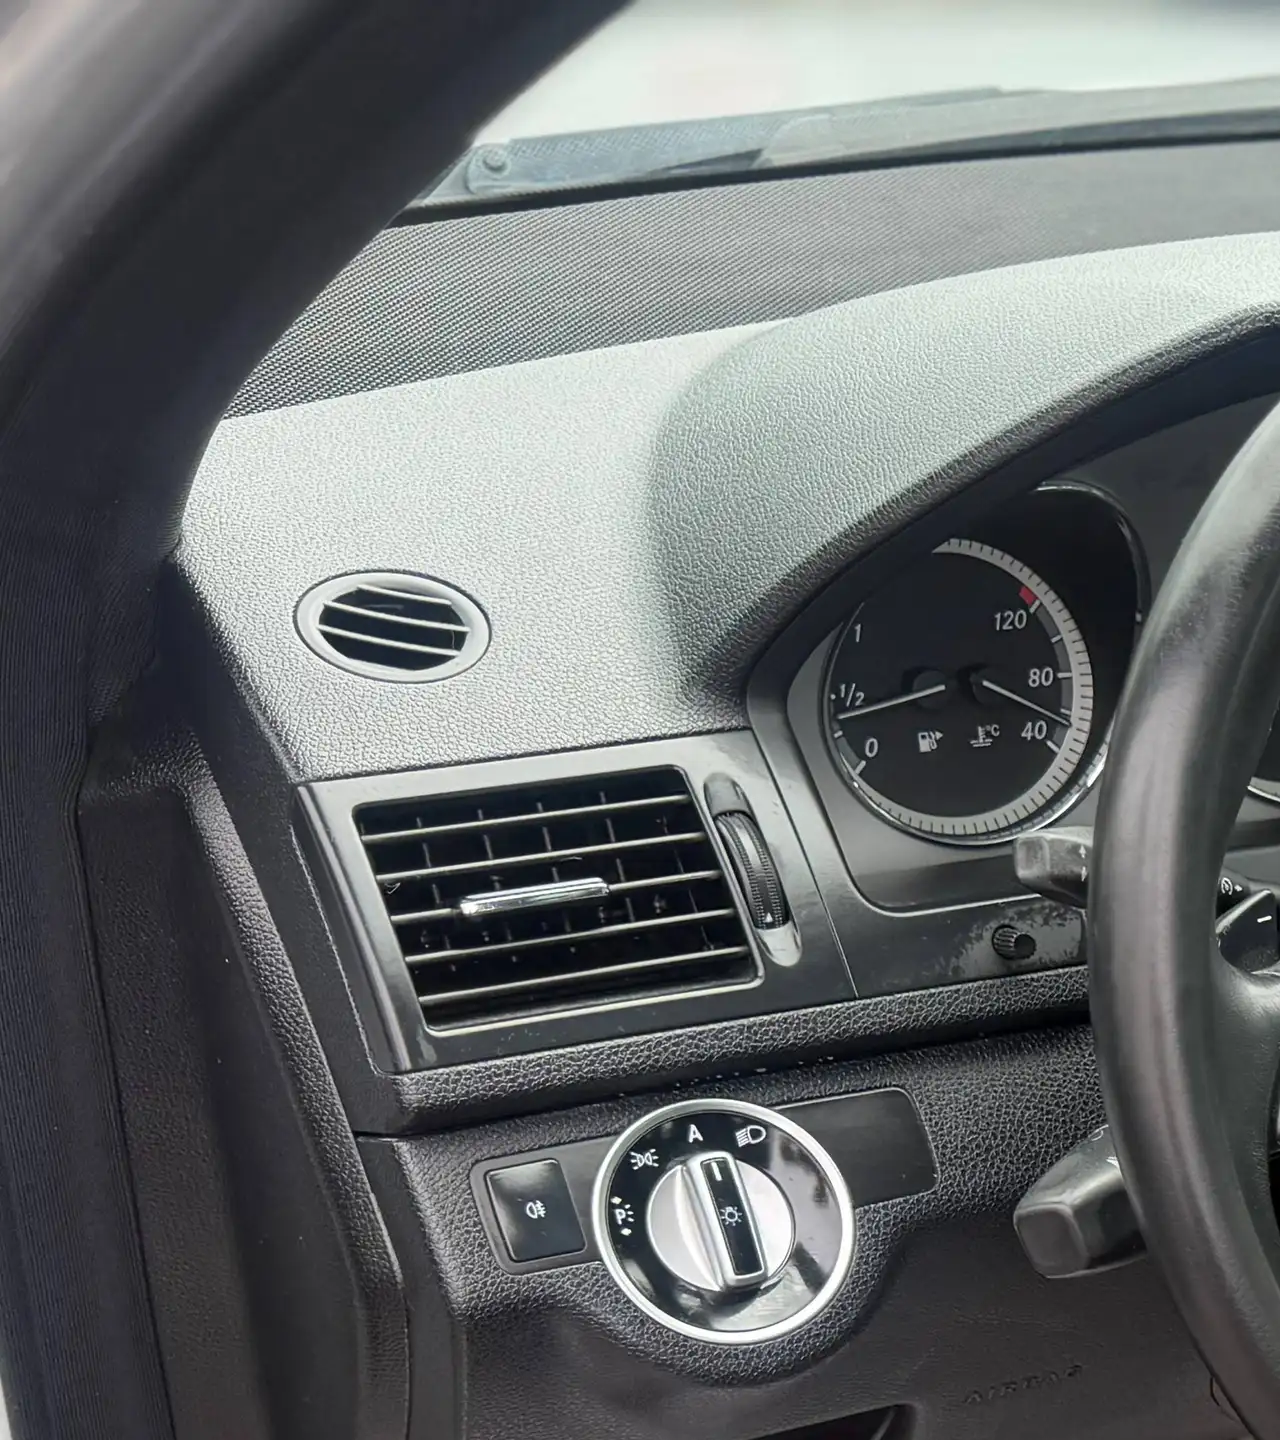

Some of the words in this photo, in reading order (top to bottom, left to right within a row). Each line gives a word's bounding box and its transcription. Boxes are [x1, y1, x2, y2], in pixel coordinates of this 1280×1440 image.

[994, 610, 1027, 632] 120
[853, 623, 862, 643] 1
[1028, 667, 1054, 688] 80
[1021, 719, 1047, 741] 40
[864, 738, 879, 758] 0
[688, 1125, 704, 1143] A
